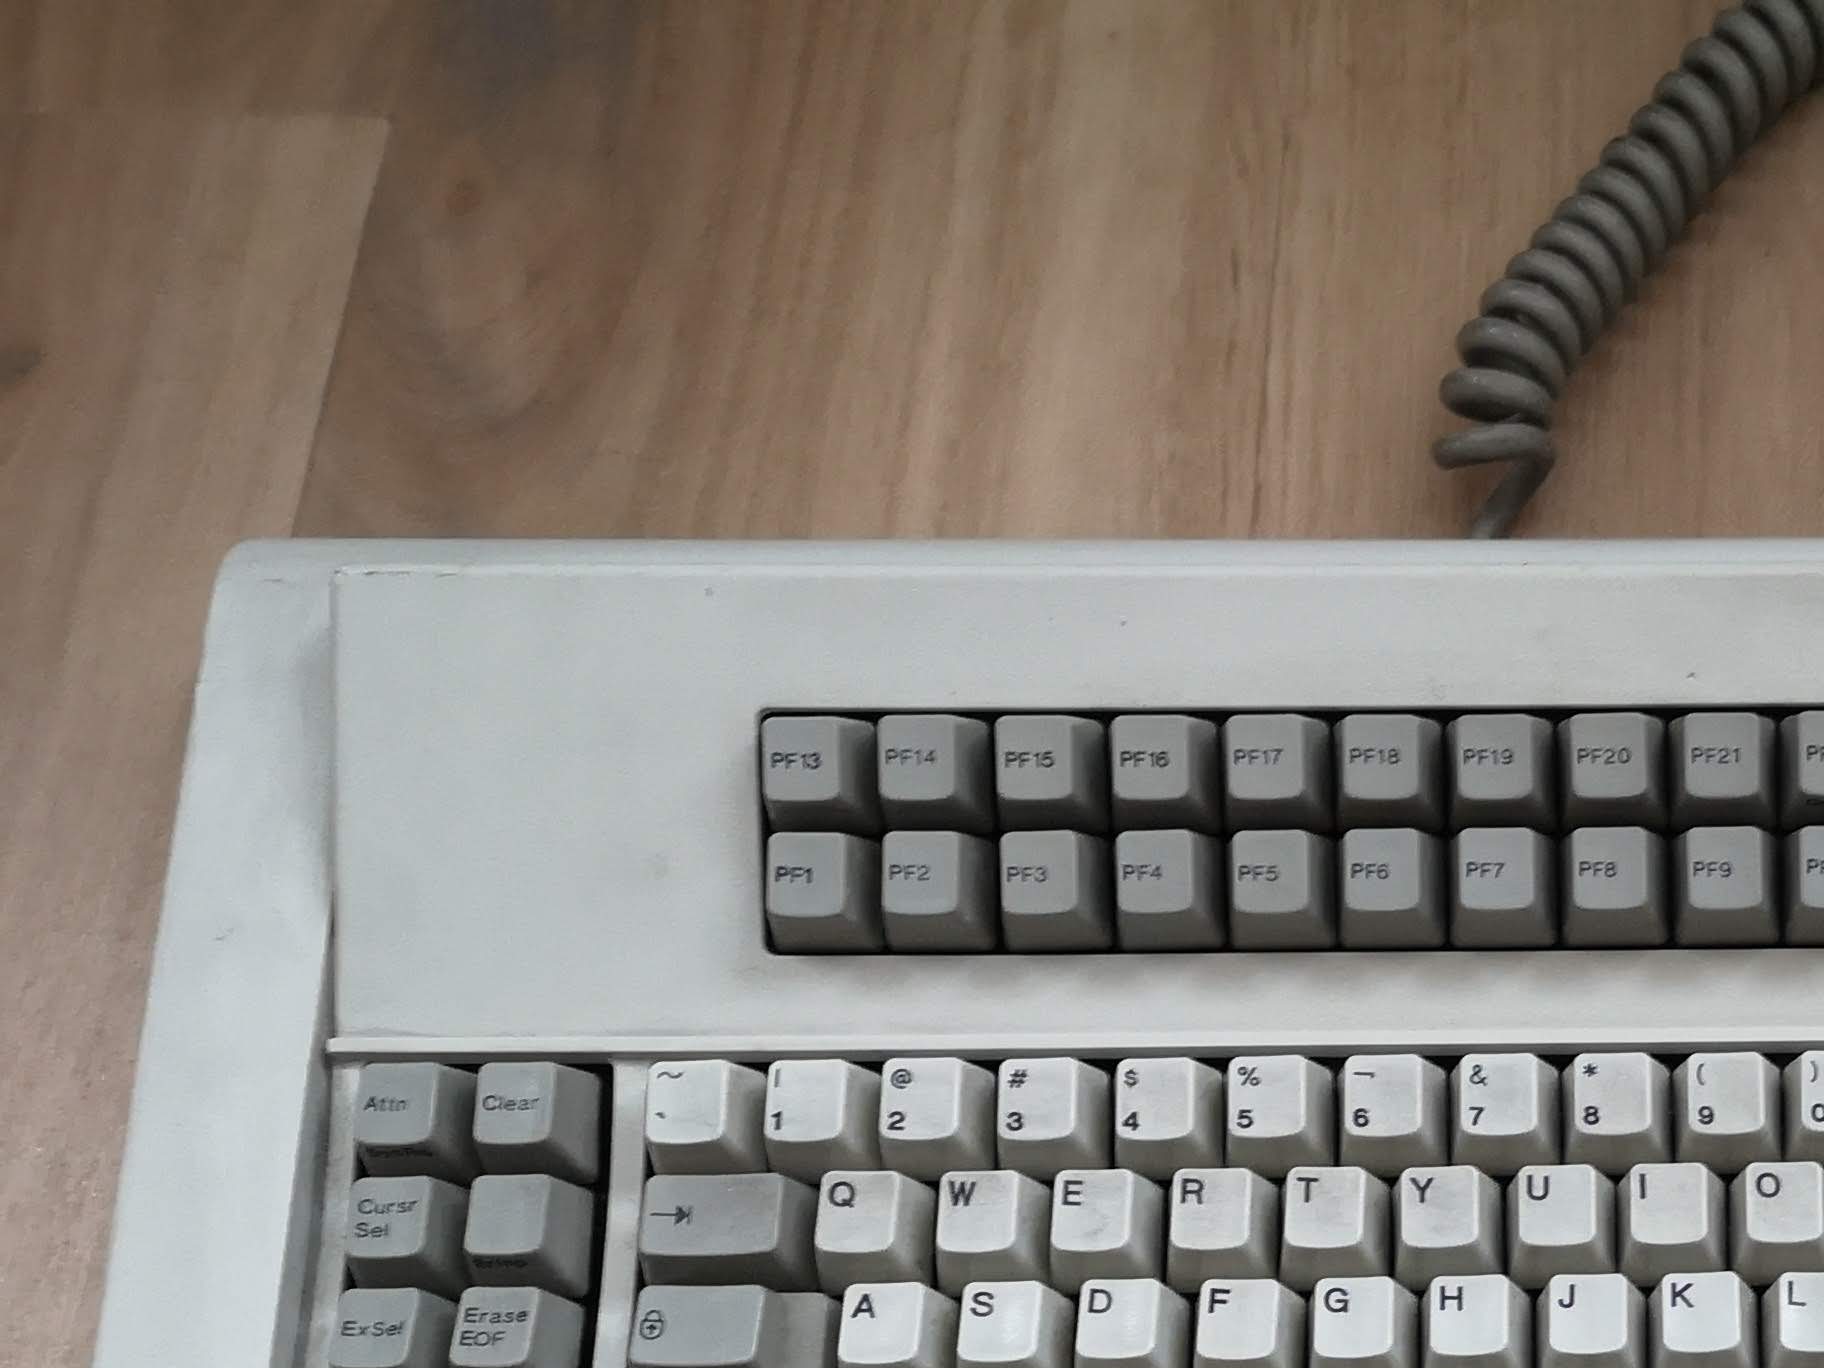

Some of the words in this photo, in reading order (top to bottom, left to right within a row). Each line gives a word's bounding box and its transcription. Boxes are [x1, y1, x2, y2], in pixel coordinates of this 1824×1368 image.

[770, 751, 822, 770] PF13
[884, 748, 936, 765] PF14
[1004, 750, 1055, 769] PF15
[1119, 750, 1170, 768] PF16
[1233, 748, 1284, 766] PF17
[1349, 747, 1401, 765] PF18
[1463, 748, 1514, 766] PF19
[1576, 747, 1633, 765] PF20
[1690, 746, 1740, 765] PF21
[774, 865, 813, 884] PF1
[888, 863, 930, 882] PF2
[1006, 866, 1048, 883] PF3
[1122, 863, 1163, 881] PF4
[1238, 864, 1280, 883] PF5
[1350, 862, 1390, 880] PF6
[1465, 861, 1505, 879] PF7
[1578, 860, 1618, 879] PF8
[1692, 860, 1732, 878] PF9
[363, 1095, 407, 1112] Attn
[482, 1094, 540, 1112] Clear
[770, 1110, 783, 1131] 1
[886, 1110, 906, 1131] 2
[1005, 1111, 1025, 1132] 3
[1121, 1111, 1140, 1132] 4
[1236, 1109, 1254, 1129] 5
[1352, 1107, 1370, 1128] 6
[1468, 1106, 1485, 1127] 7
[1582, 1105, 1600, 1126] 8
[1698, 1105, 1715, 1126] 9
[828, 1180, 856, 1209] Q
[948, 1180, 977, 1207] W
[1061, 1179, 1084, 1207] E
[1180, 1177, 1205, 1205] R
[1295, 1176, 1320, 1204] T
[1409, 1177, 1434, 1204] Y
[1526, 1174, 1550, 1201] U
[1638, 1173, 1647, 1200] I
[1755, 1172, 1781, 1199] O
[357, 1198, 419, 1215] Cursr
[354, 1221, 389, 1239] Sel
[1087, 1288, 1113, 1314] D
[1208, 1287, 1232, 1314] F
[1323, 1287, 1350, 1313] G
[1439, 1285, 1464, 1312] H
[1557, 1283, 1576, 1309] J
[1670, 1282, 1695, 1309] K
[1787, 1280, 1807, 1307] L
[850, 1293, 876, 1319] A
[969, 1291, 995, 1318] S
[463, 1307, 529, 1324] Erase
[340, 1320, 405, 1337] ExSel
[459, 1329, 506, 1347] EOF
